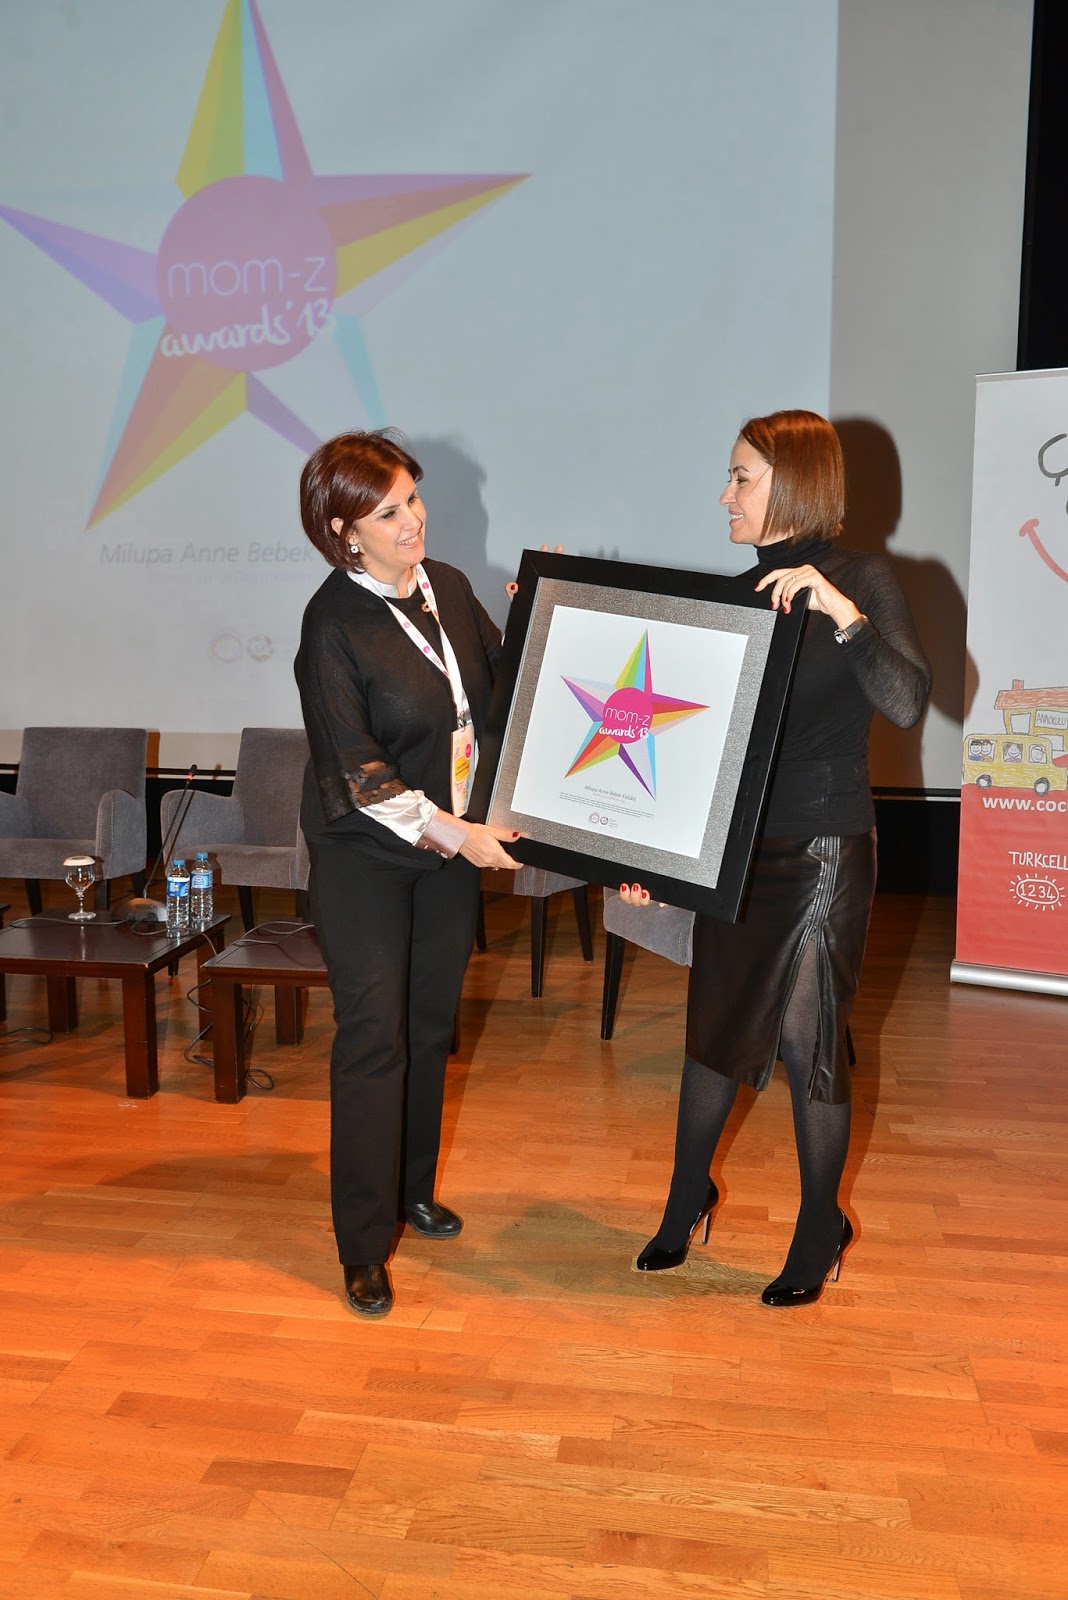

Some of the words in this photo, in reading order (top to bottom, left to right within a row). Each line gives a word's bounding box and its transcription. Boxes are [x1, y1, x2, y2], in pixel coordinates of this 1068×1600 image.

[167, 256, 328, 298] mom-z
[101, 543, 174, 568] Milupa
[180, 543, 240, 563] Anne
[247, 541, 314, 563] Bebek
[605, 707, 650, 726] mom-z
[982, 796, 1068, 813] www.coc
